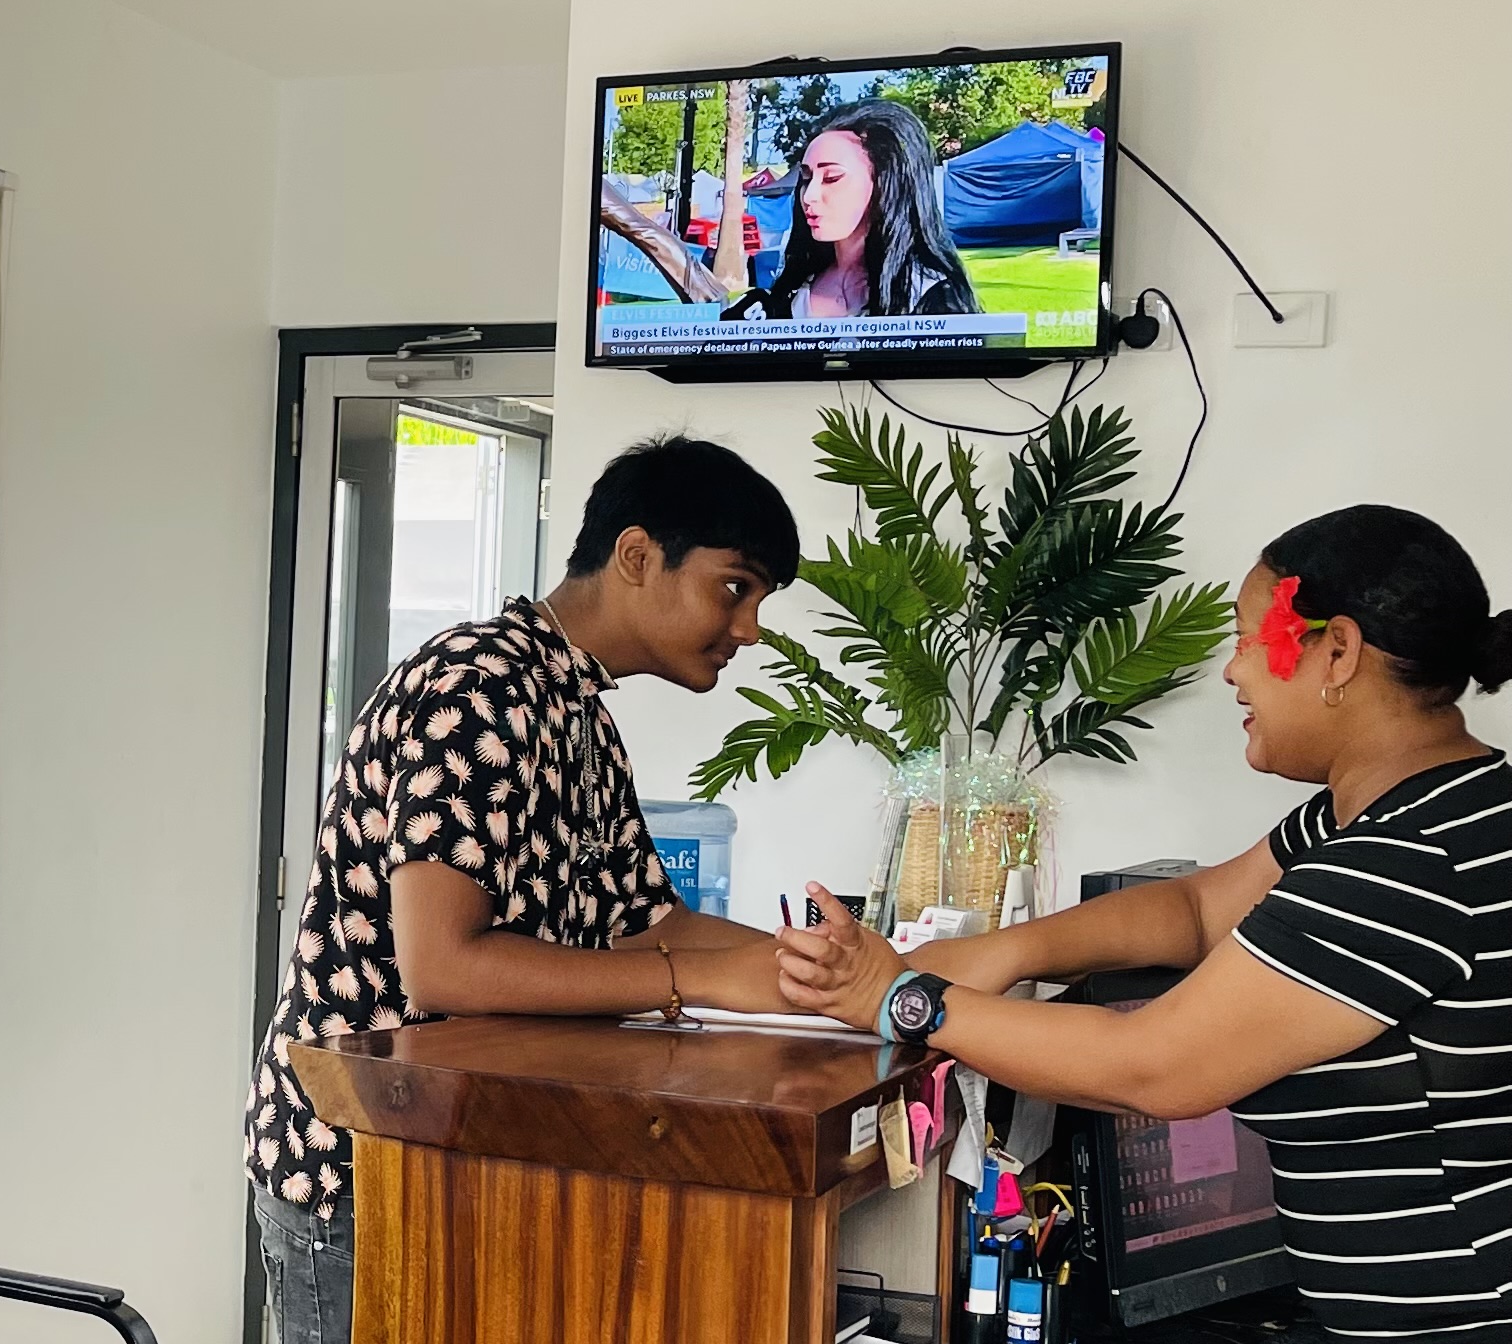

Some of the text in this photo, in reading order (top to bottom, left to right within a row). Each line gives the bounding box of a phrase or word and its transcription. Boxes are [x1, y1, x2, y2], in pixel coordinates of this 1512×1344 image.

[1065, 70, 1096, 84] FBC
[618, 93, 639, 103] LIVE
[689, 87, 716, 100] NSW
[1069, 83, 1087, 94] TV
[611, 306, 709, 321] ELVIS FESTIVAL
[612, 319, 947, 340] Biggest Elvis festival resumes today in regional NSW
[610, 337, 984, 355] State of emergency declared in Papua New Guinea after deadly violent riots
